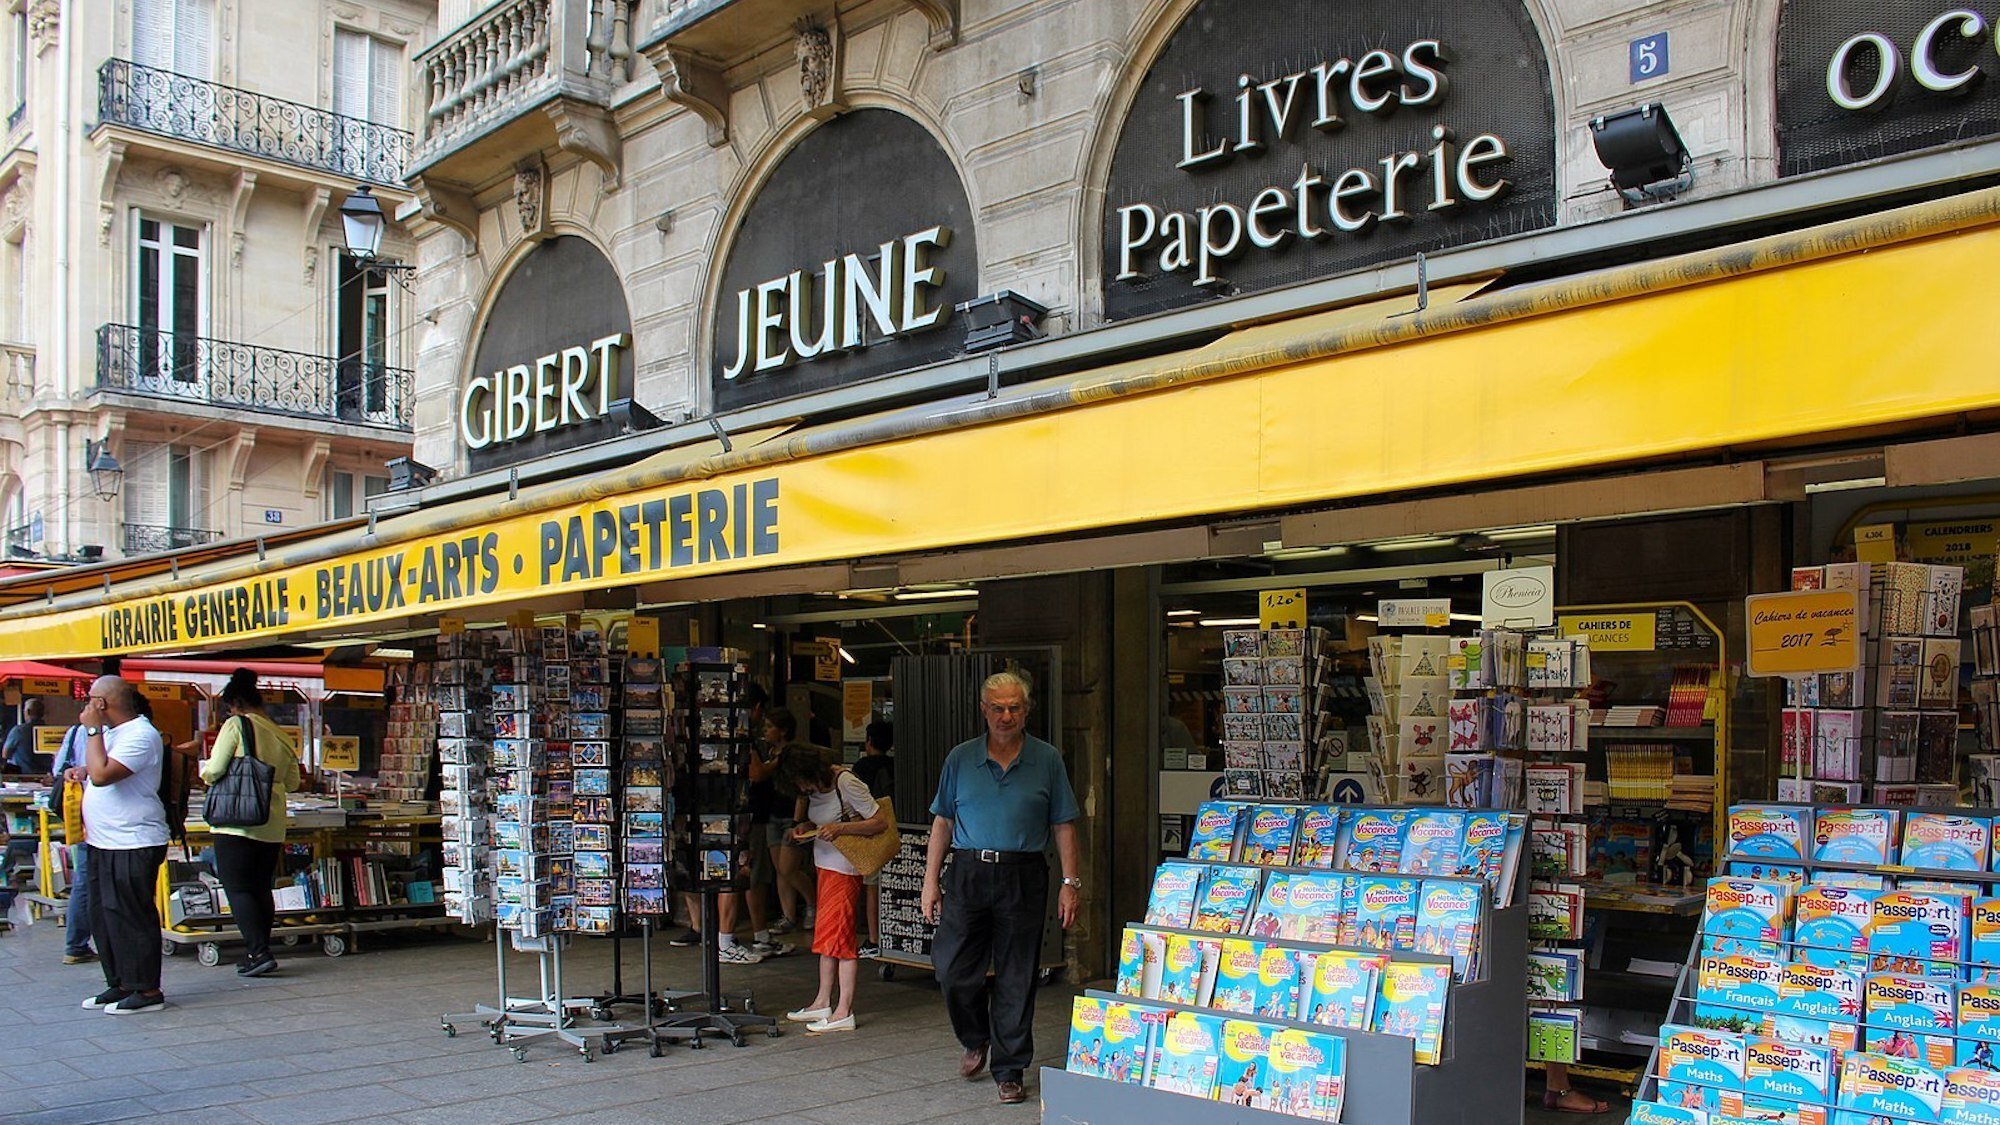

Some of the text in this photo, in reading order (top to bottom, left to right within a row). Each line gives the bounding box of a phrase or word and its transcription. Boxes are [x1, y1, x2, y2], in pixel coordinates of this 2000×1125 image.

[1639, 39, 1658, 74] 5
[1826, 8, 2000, 110] oc
[1175, 38, 1447, 172] Livres
[1116, 124, 1510, 288] Papeterie
[723, 225, 950, 381] JEUNE
[460, 333, 629, 449] GIBERT
[266, 511, 282, 523] 38
[1924, 524, 1993, 537] CALENDRIERS
[1944, 543, 1972, 552] 2018
[101, 477, 779, 650] LIBRAIRIE GENERALE BEAUX-ARTS PAPETERIE
[1495, 585, 1542, 600] Phenicia
[1754, 607, 1855, 626] Cahiers de vacances
[1578, 620, 1632, 630] CAHIERS DE
[1589, 633, 1629, 643] ACANCES
[1781, 633, 1814, 649] 2017
[1200, 818, 1231, 828] Vacances
[1255, 819, 1288, 828] Vacances
[1304, 819, 1332, 829] Vacances
[1357, 824, 1398, 834] Vacances
[1411, 825, 1455, 837] Vacances
[1732, 818, 1797, 834] Passeport
[1818, 820, 1884, 835] Passeport
[1469, 826, 1502, 838] Vacances
[1909, 823, 1982, 841] Passeport
[1210, 887, 1245, 897] Vacances
[1293, 889, 1334, 900] Vacances
[1365, 893, 1408, 904] Vacances
[1708, 887, 1774, 906] Passeport
[1427, 898, 1470, 909] Vacances
[1798, 895, 1868, 914] Passeport
[1873, 901, 1951, 920] Passeport
[1718, 961, 1781, 984] Passepor
[1781, 969, 1853, 992] Passeport
[1393, 982, 1436, 992] vacances
[1868, 981, 1948, 1004] Passeport
[1725, 990, 1775, 1007] Français
[1792, 1000, 1838, 1016] Anglais
[1884, 1012, 1933, 1028] Anglais
[1233, 1040, 1270, 1052] vacance
[1284, 1041, 1310, 1054] Cahier
[1671, 1038, 1740, 1062] Passeport
[1280, 1050, 1324, 1063] vacances
[1748, 1048, 1822, 1073] Passeport
[1687, 1067, 1723, 1082] Maths
[1858, 1064, 1940, 1093] Passeport
[1764, 1079, 1804, 1095] Maths
[1872, 1096, 1916, 1116] Maths
[1956, 1109, 2000, 1124] Maths
